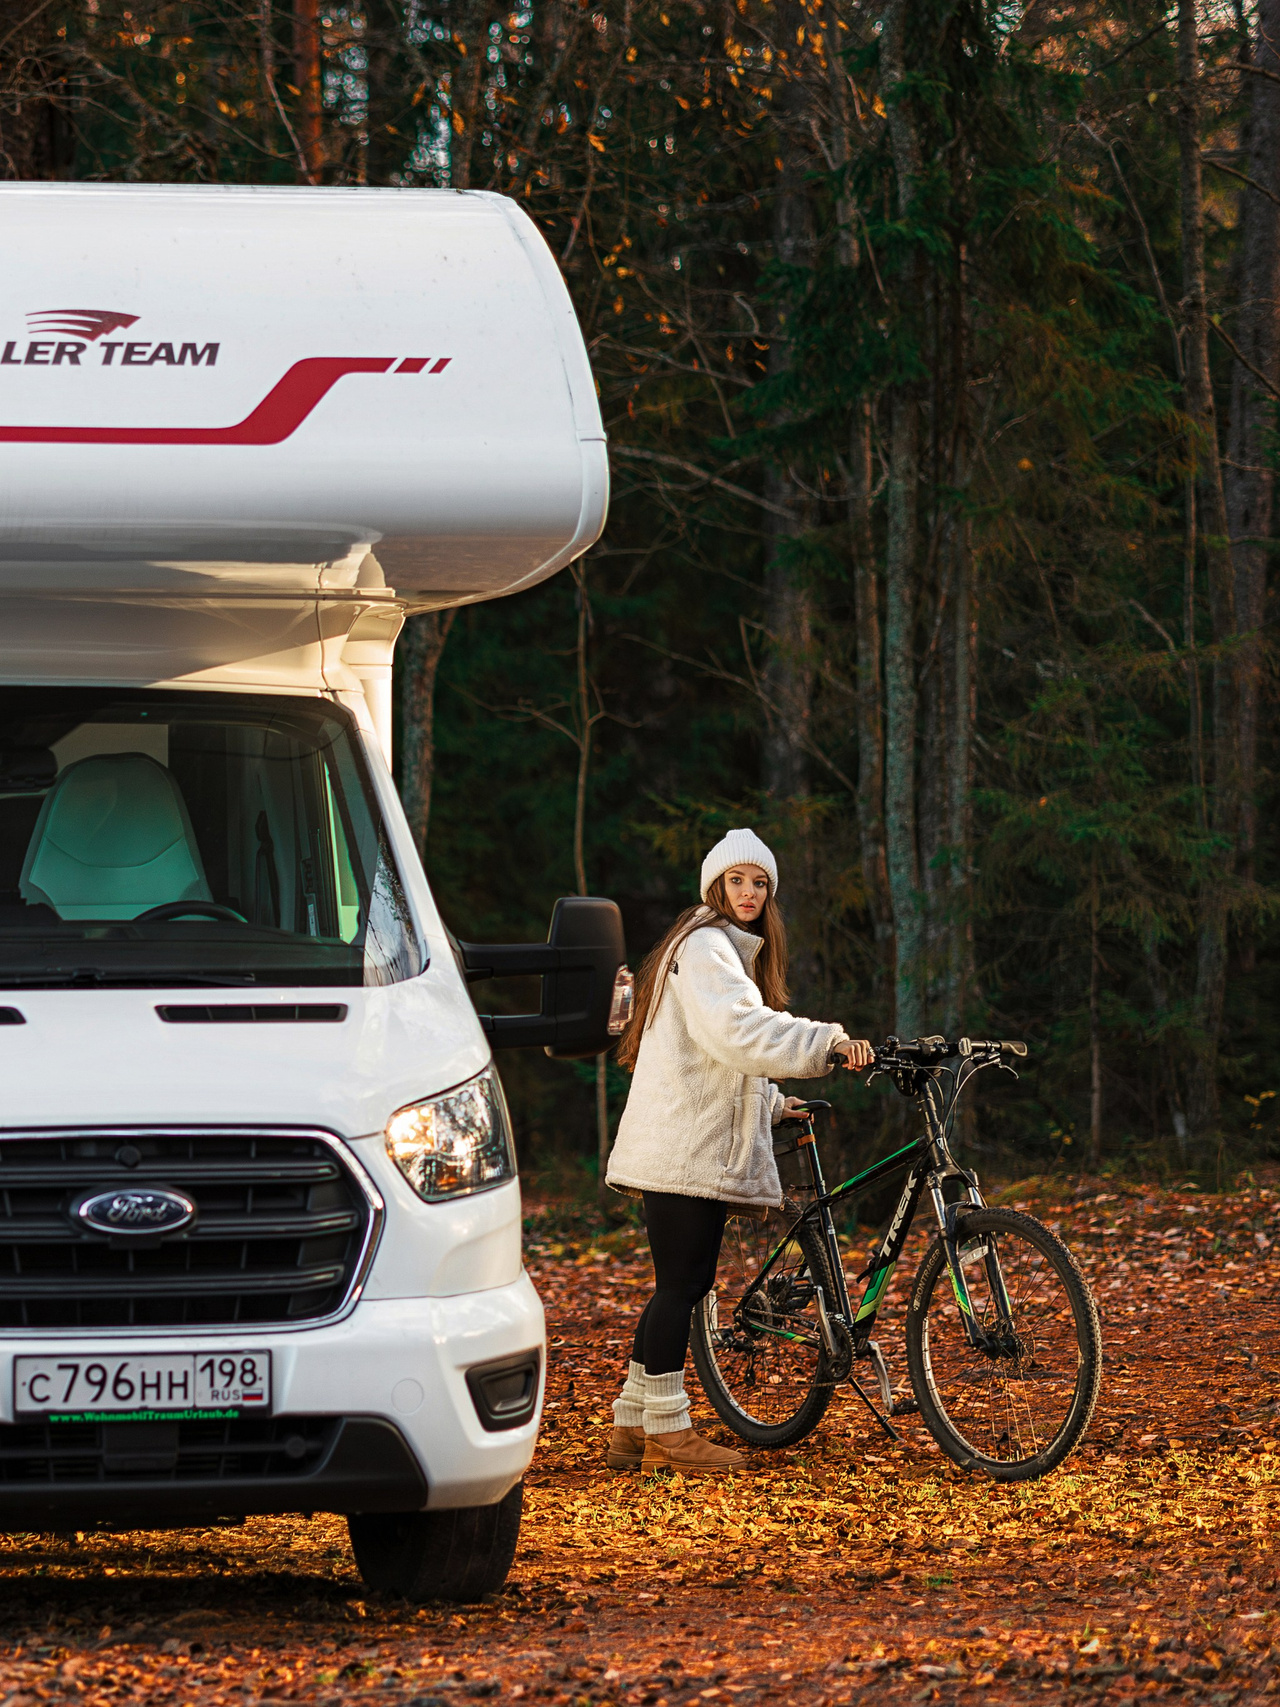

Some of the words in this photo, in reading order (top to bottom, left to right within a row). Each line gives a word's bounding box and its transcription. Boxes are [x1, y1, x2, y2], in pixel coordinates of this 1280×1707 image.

[99, 342, 220, 366] TEAM
[107, 1197, 169, 1222] Ford
[880, 1170, 917, 1257] TREK
[916, 1248, 941, 1302] BONTRAGER
[199, 1358, 257, 1388] 198
[211, 1389, 240, 1401] RUS
